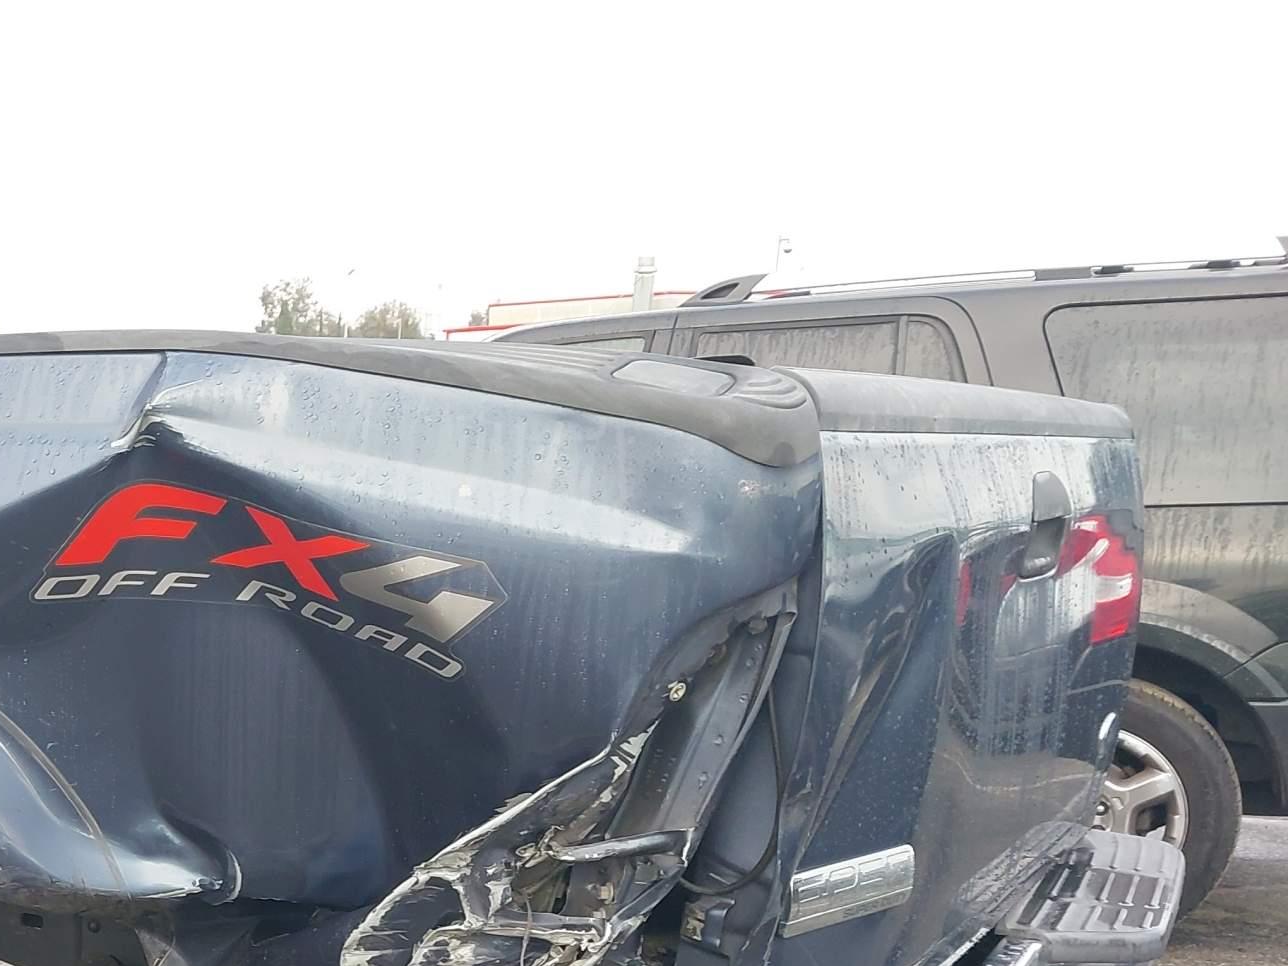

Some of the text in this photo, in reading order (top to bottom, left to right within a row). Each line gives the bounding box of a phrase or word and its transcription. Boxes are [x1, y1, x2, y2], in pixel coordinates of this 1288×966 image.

[33, 570, 465, 680] OFF ROAD
[55, 483, 495, 643] FX4
